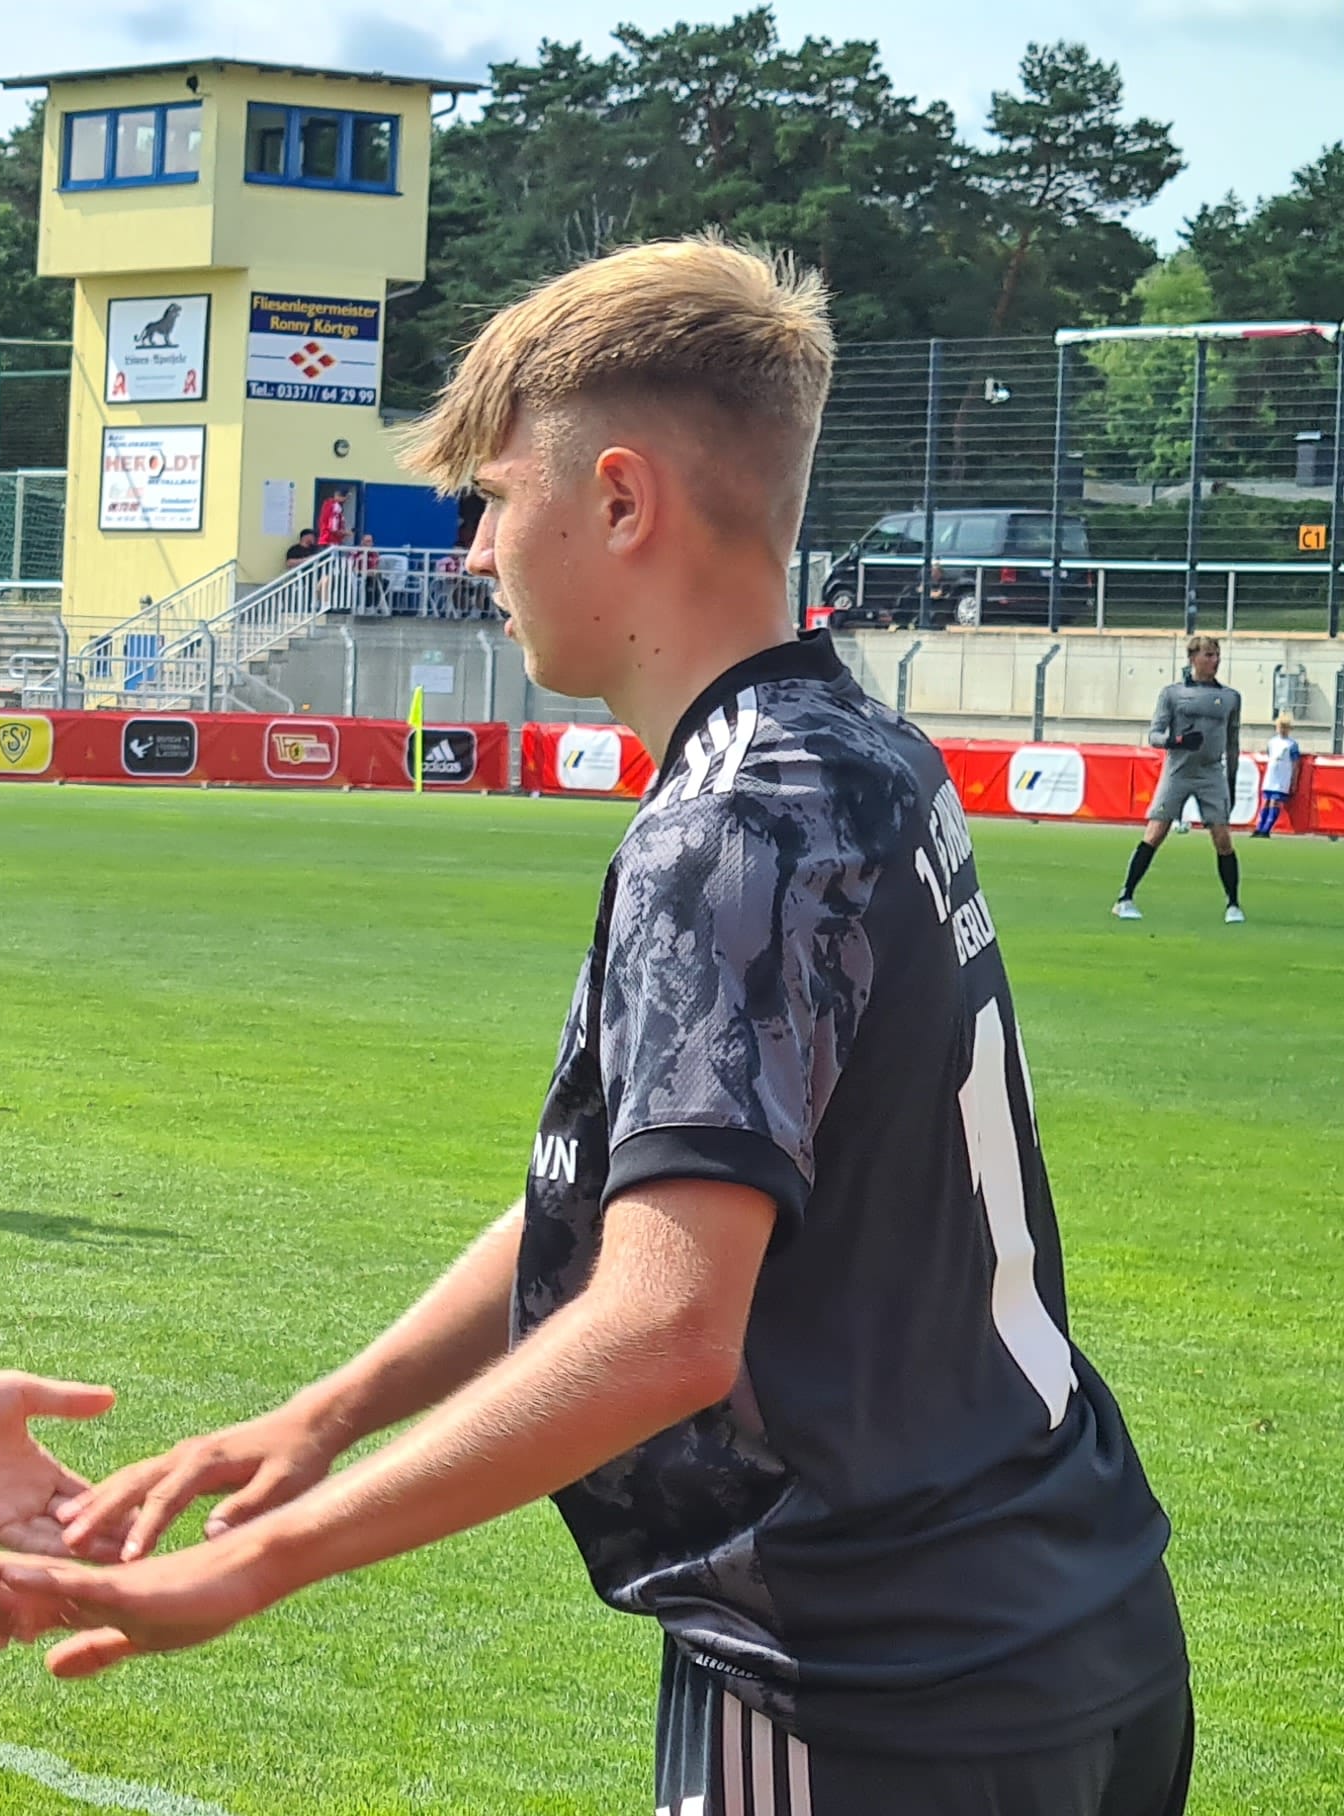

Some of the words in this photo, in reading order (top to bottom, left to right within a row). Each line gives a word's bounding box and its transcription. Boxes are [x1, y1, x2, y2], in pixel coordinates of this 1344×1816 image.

[254, 296, 377, 318] Fliesenlegermeister
[270, 315, 311, 335] Ronny
[314, 318, 359, 339] Körtge
[249, 382, 274, 396] Tel.:
[322, 388, 337, 400] 64
[340, 390, 356, 402] 29
[359, 390, 375, 403] 99
[1302, 530, 1320, 548] C1
